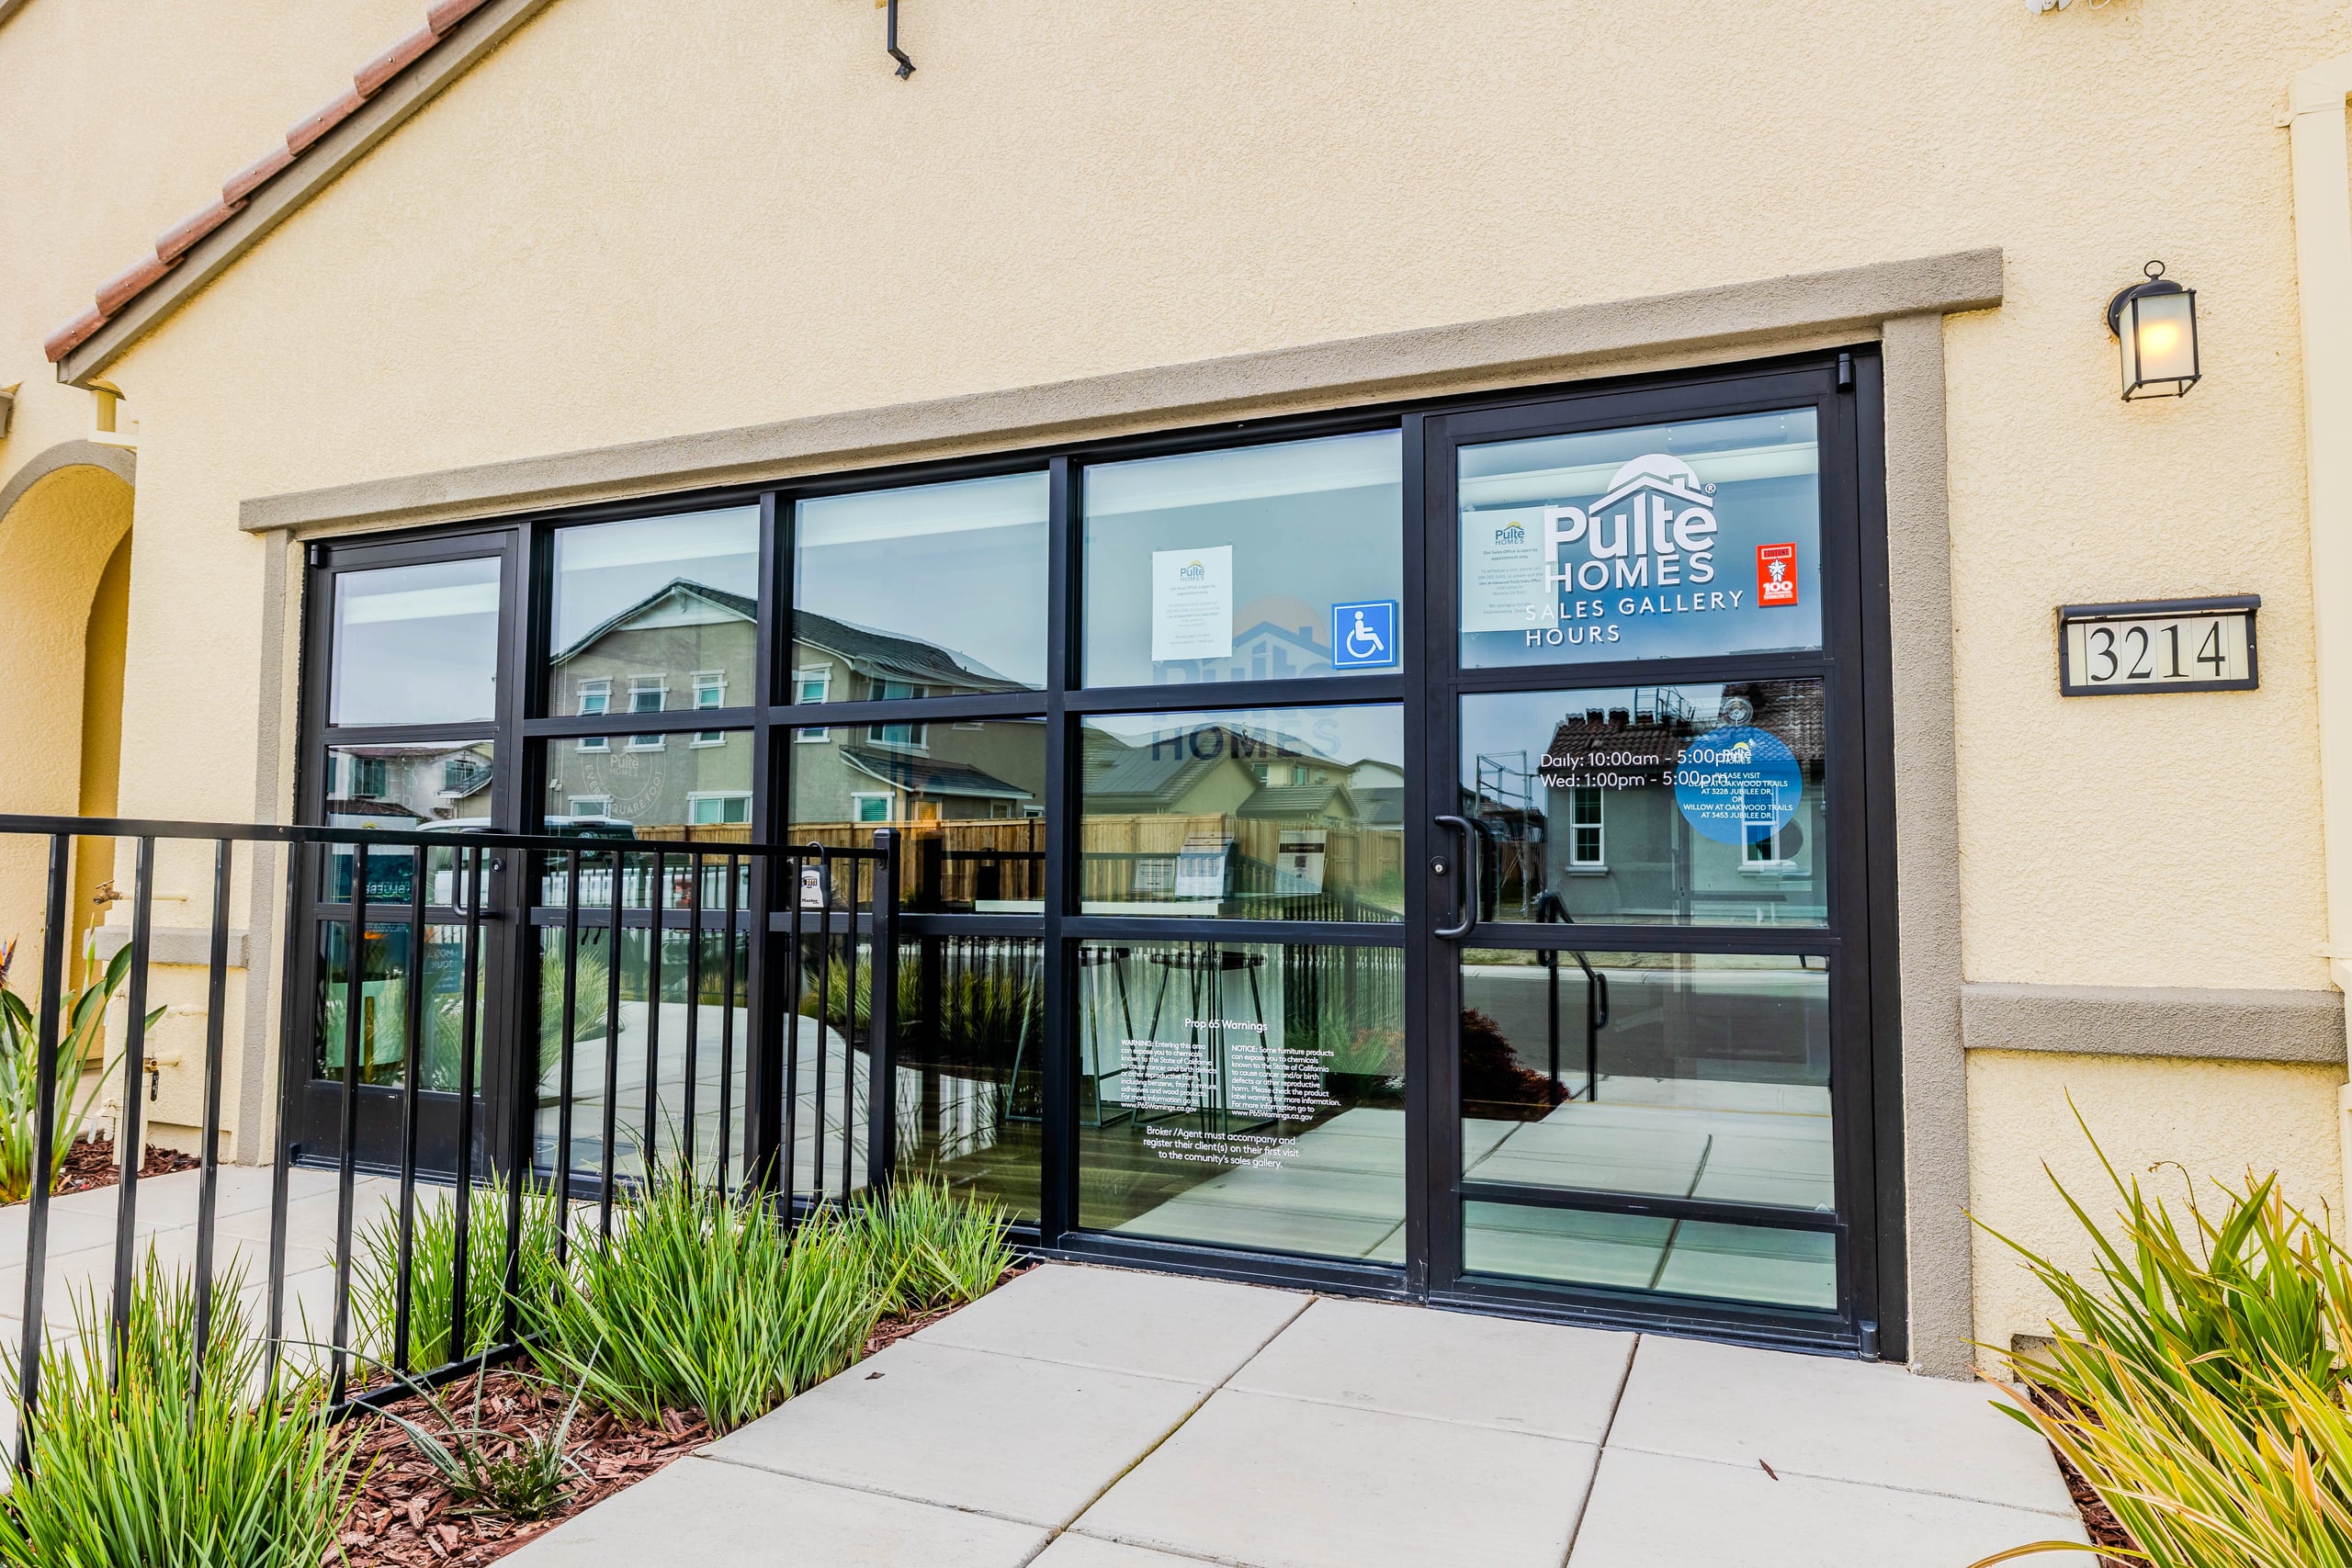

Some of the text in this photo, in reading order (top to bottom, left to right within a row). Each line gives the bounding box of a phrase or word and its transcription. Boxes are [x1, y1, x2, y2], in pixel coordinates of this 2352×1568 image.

[1496, 528, 1524, 539] Pulte
[1544, 491, 1717, 562] Pulte
[1764, 548, 1790, 558] FORTUNE
[1181, 567, 1204, 577] Pulte
[1544, 553, 1714, 593] HOMES
[1763, 581, 1792, 592] 100
[1525, 590, 1744, 621] SALES GALLERY
[1526, 625, 1621, 647] HOURS
[2090, 621, 2225, 682] 3214
[611, 754, 639, 769] Pulte
[1541, 753, 1584, 770] Daily:
[1588, 751, 1659, 765] 10:00am
[610, 768, 639, 776] HOMES
[1540, 773, 1580, 787] Wed:
[1584, 773, 1645, 790] 1:00pm
[1663, 771, 1727, 789] 5:00pm
[611, 799, 645, 814] QUARE
[645, 771, 662, 801] FOOT
[1185, 1019, 1268, 1032] Prop 65 Warnings
[1156, 1041, 1179, 1049] Entering
[1121, 1078, 1147, 1087] including
[1248, 1095, 1272, 1103] warning
[1302, 1097, 1341, 1106] information.
[1261, 1101, 1296, 1111] information
[1147, 1126, 1171, 1136] Broker
[1204, 1131, 1226, 1140] must
[1227, 1133, 1277, 1145] accompany
[1279, 1135, 1295, 1145] and
[1144, 1138, 1171, 1148] register
[1175, 1140, 1193, 1149] their
[1195, 1141, 1227, 1154] client(s)
[1243, 1145, 1261, 1154] their
[1264, 1145, 1281, 1156] first
[1283, 1148, 1299, 1157] visit
[1159, 1150, 1167, 1158] to
[1169, 1151, 1182, 1159] the
[1231, 1156, 1250, 1165] sales
[1252, 1157, 1283, 1169] gallery.
